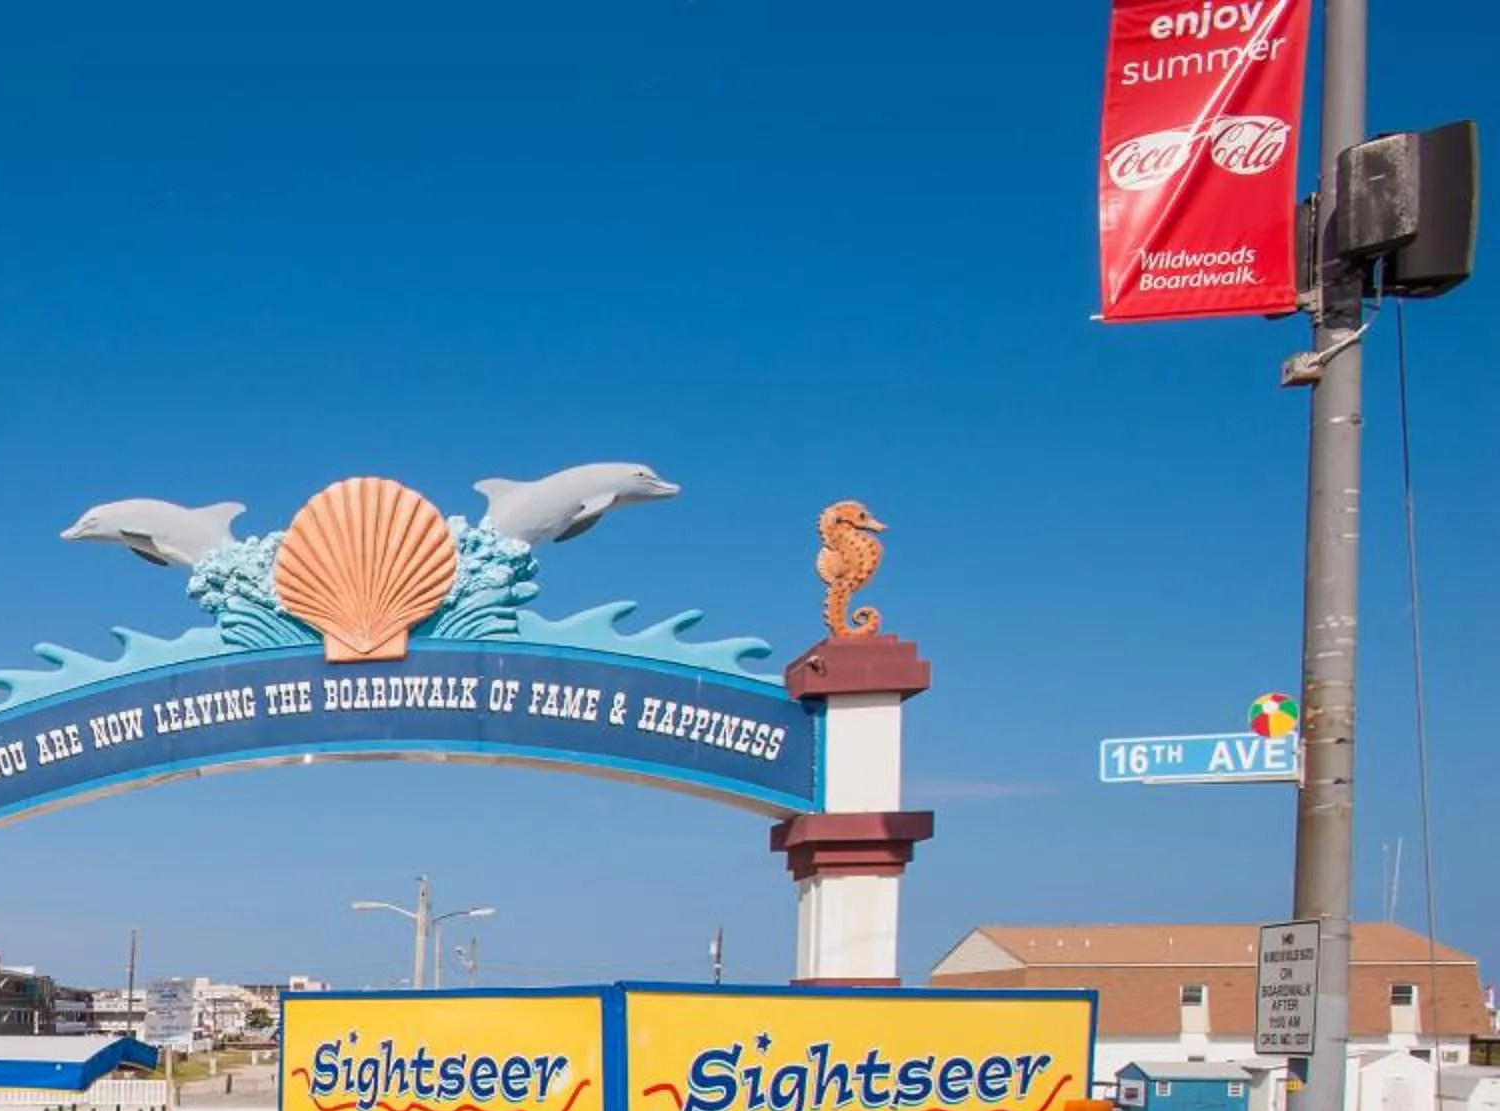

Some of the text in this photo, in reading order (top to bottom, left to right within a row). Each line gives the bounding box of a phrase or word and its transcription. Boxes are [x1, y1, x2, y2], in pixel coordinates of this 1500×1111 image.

[1150, 0, 1263, 40] enjoy
[1121, 33, 1286, 86] summer
[1139, 245, 1256, 271] Wildwoods
[1139, 266, 1257, 292] Boardwalk
[36, 724, 83, 765] ARE
[90, 710, 146, 749] NOW
[153, 687, 257, 735] LEAVING
[265, 681, 313, 716] THE
[323, 676, 480, 711] BOARDWALK
[487, 679, 520, 713] OF
[528, 682, 601, 722] FAME
[608, 691, 628, 726] &
[637, 696, 787, 762] HAPPINESS
[1111, 738, 1288, 776] 16TH AVE
